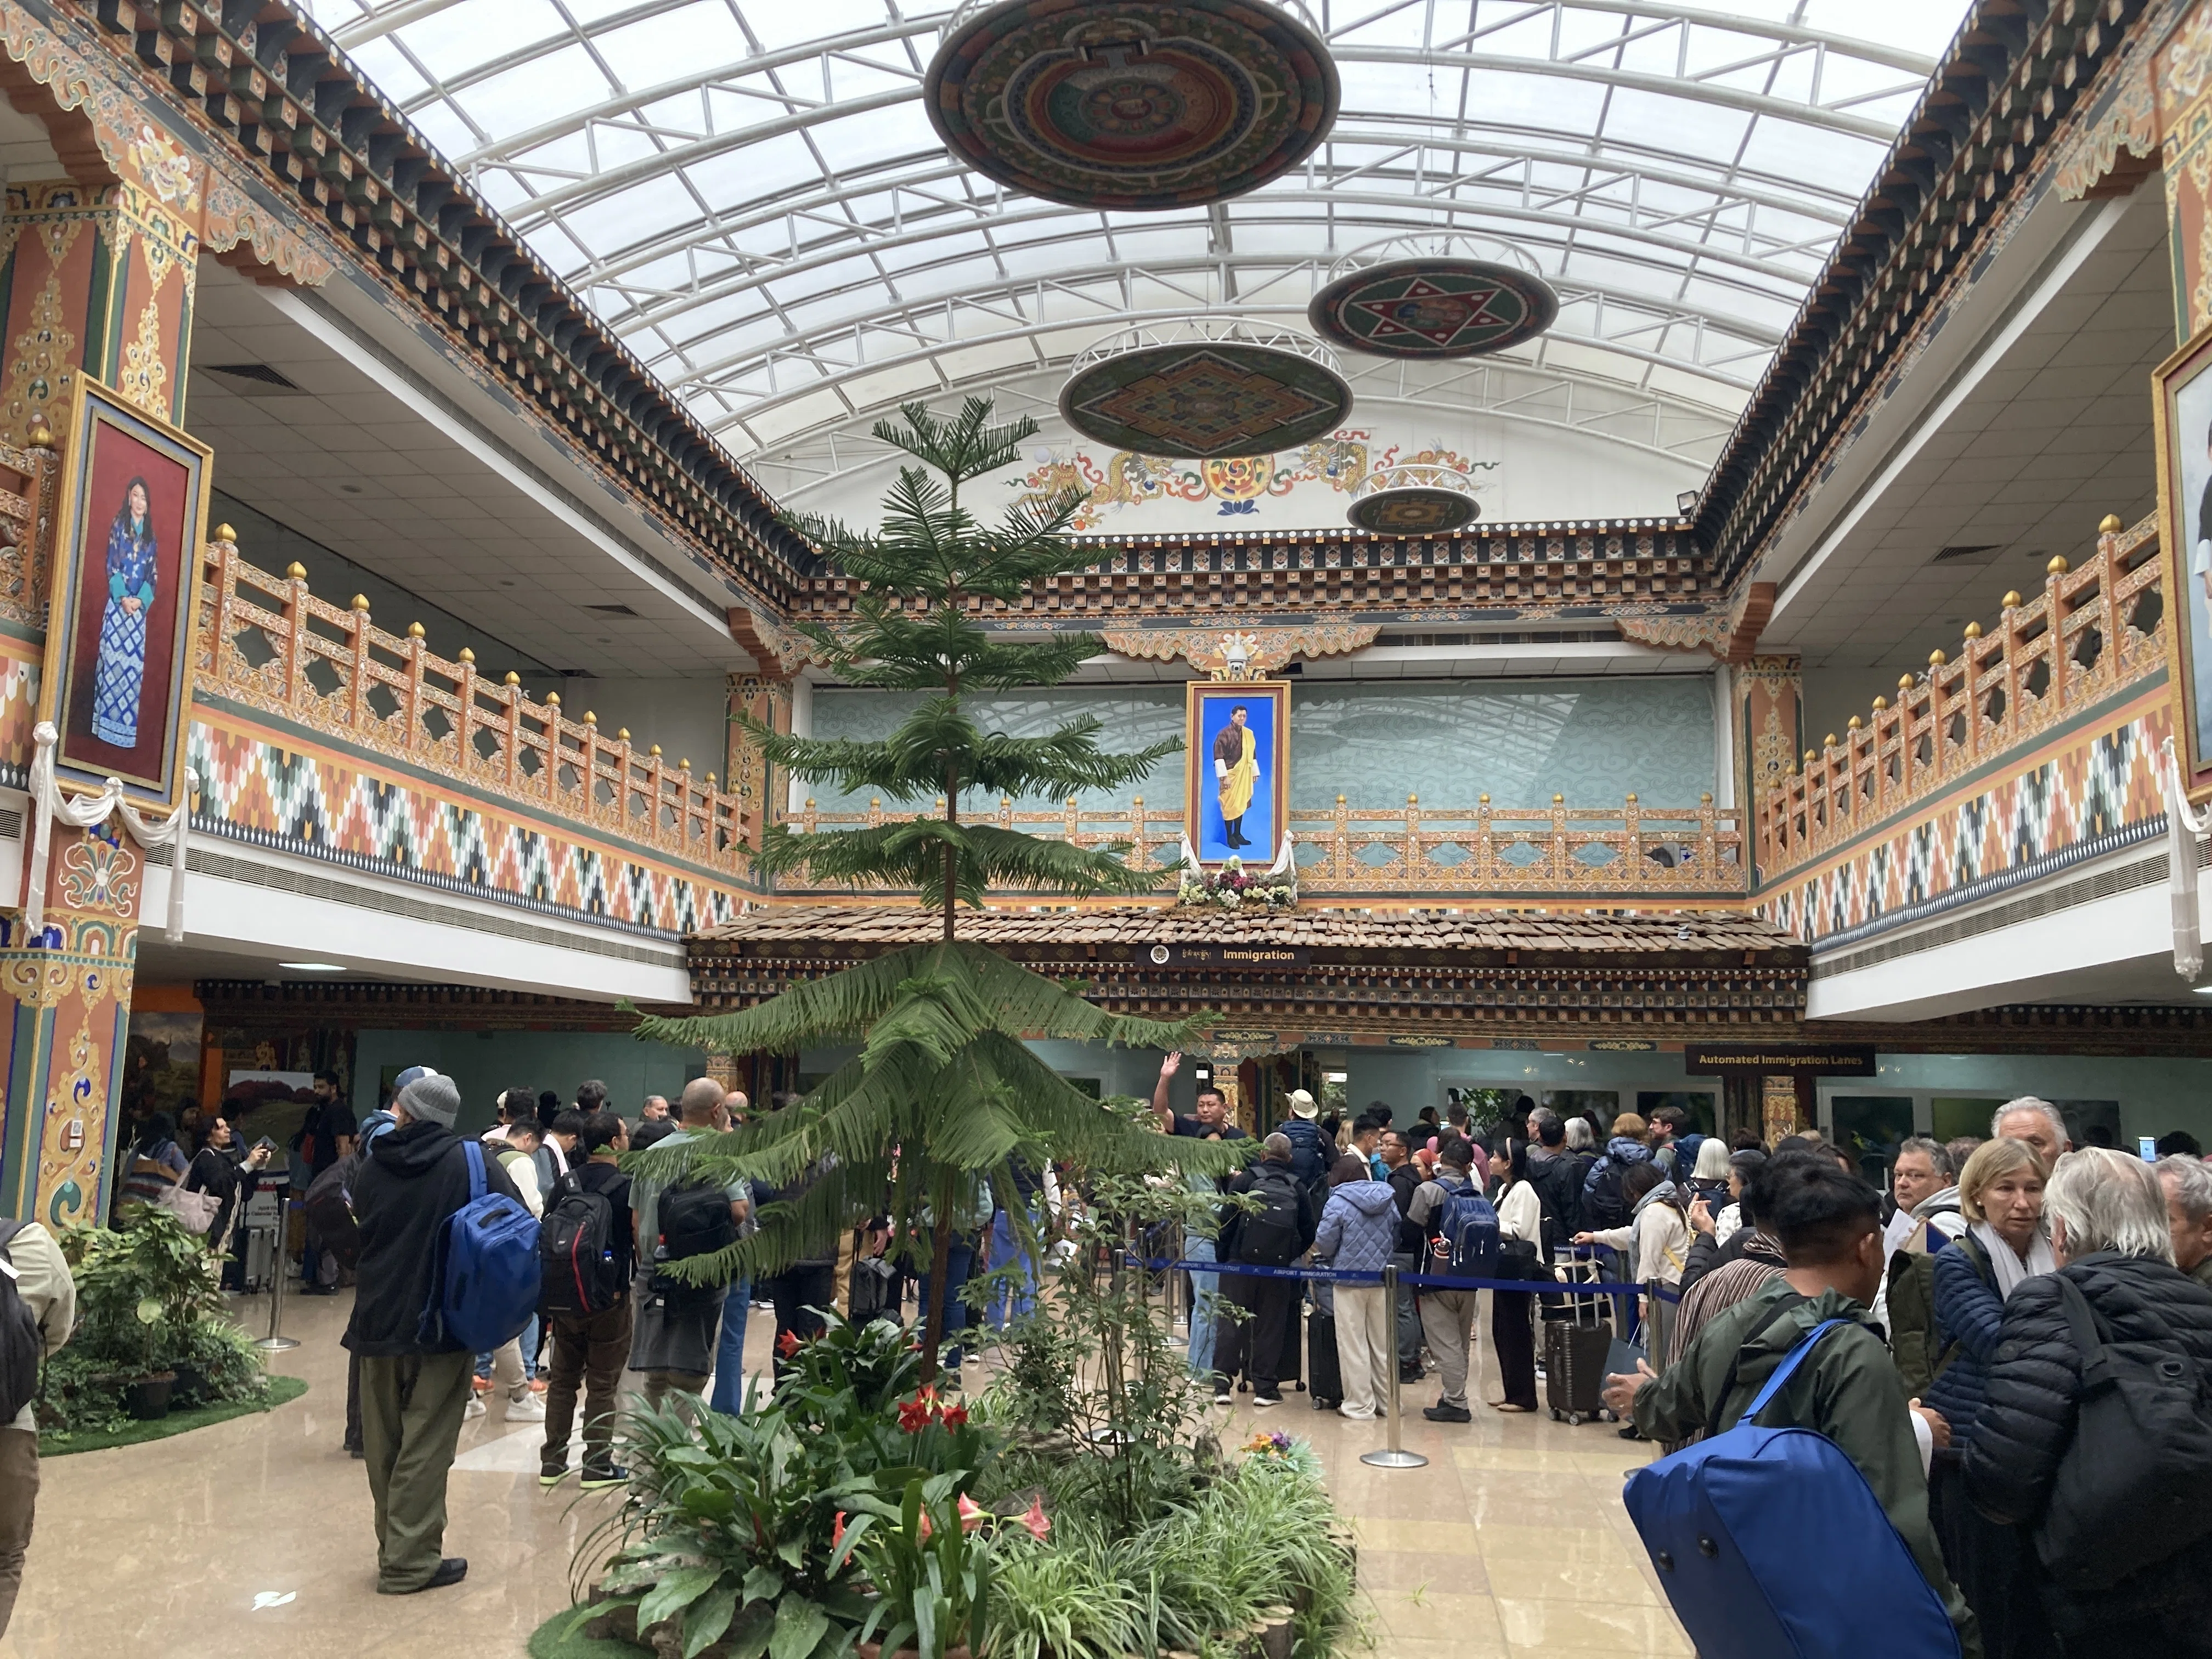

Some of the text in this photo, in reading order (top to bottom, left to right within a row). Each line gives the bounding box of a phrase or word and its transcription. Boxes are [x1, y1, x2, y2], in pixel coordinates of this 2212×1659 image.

[1223, 949, 1295, 962] Immigration
[1699, 1054, 1863, 1066] Automated Immigration Lanes
